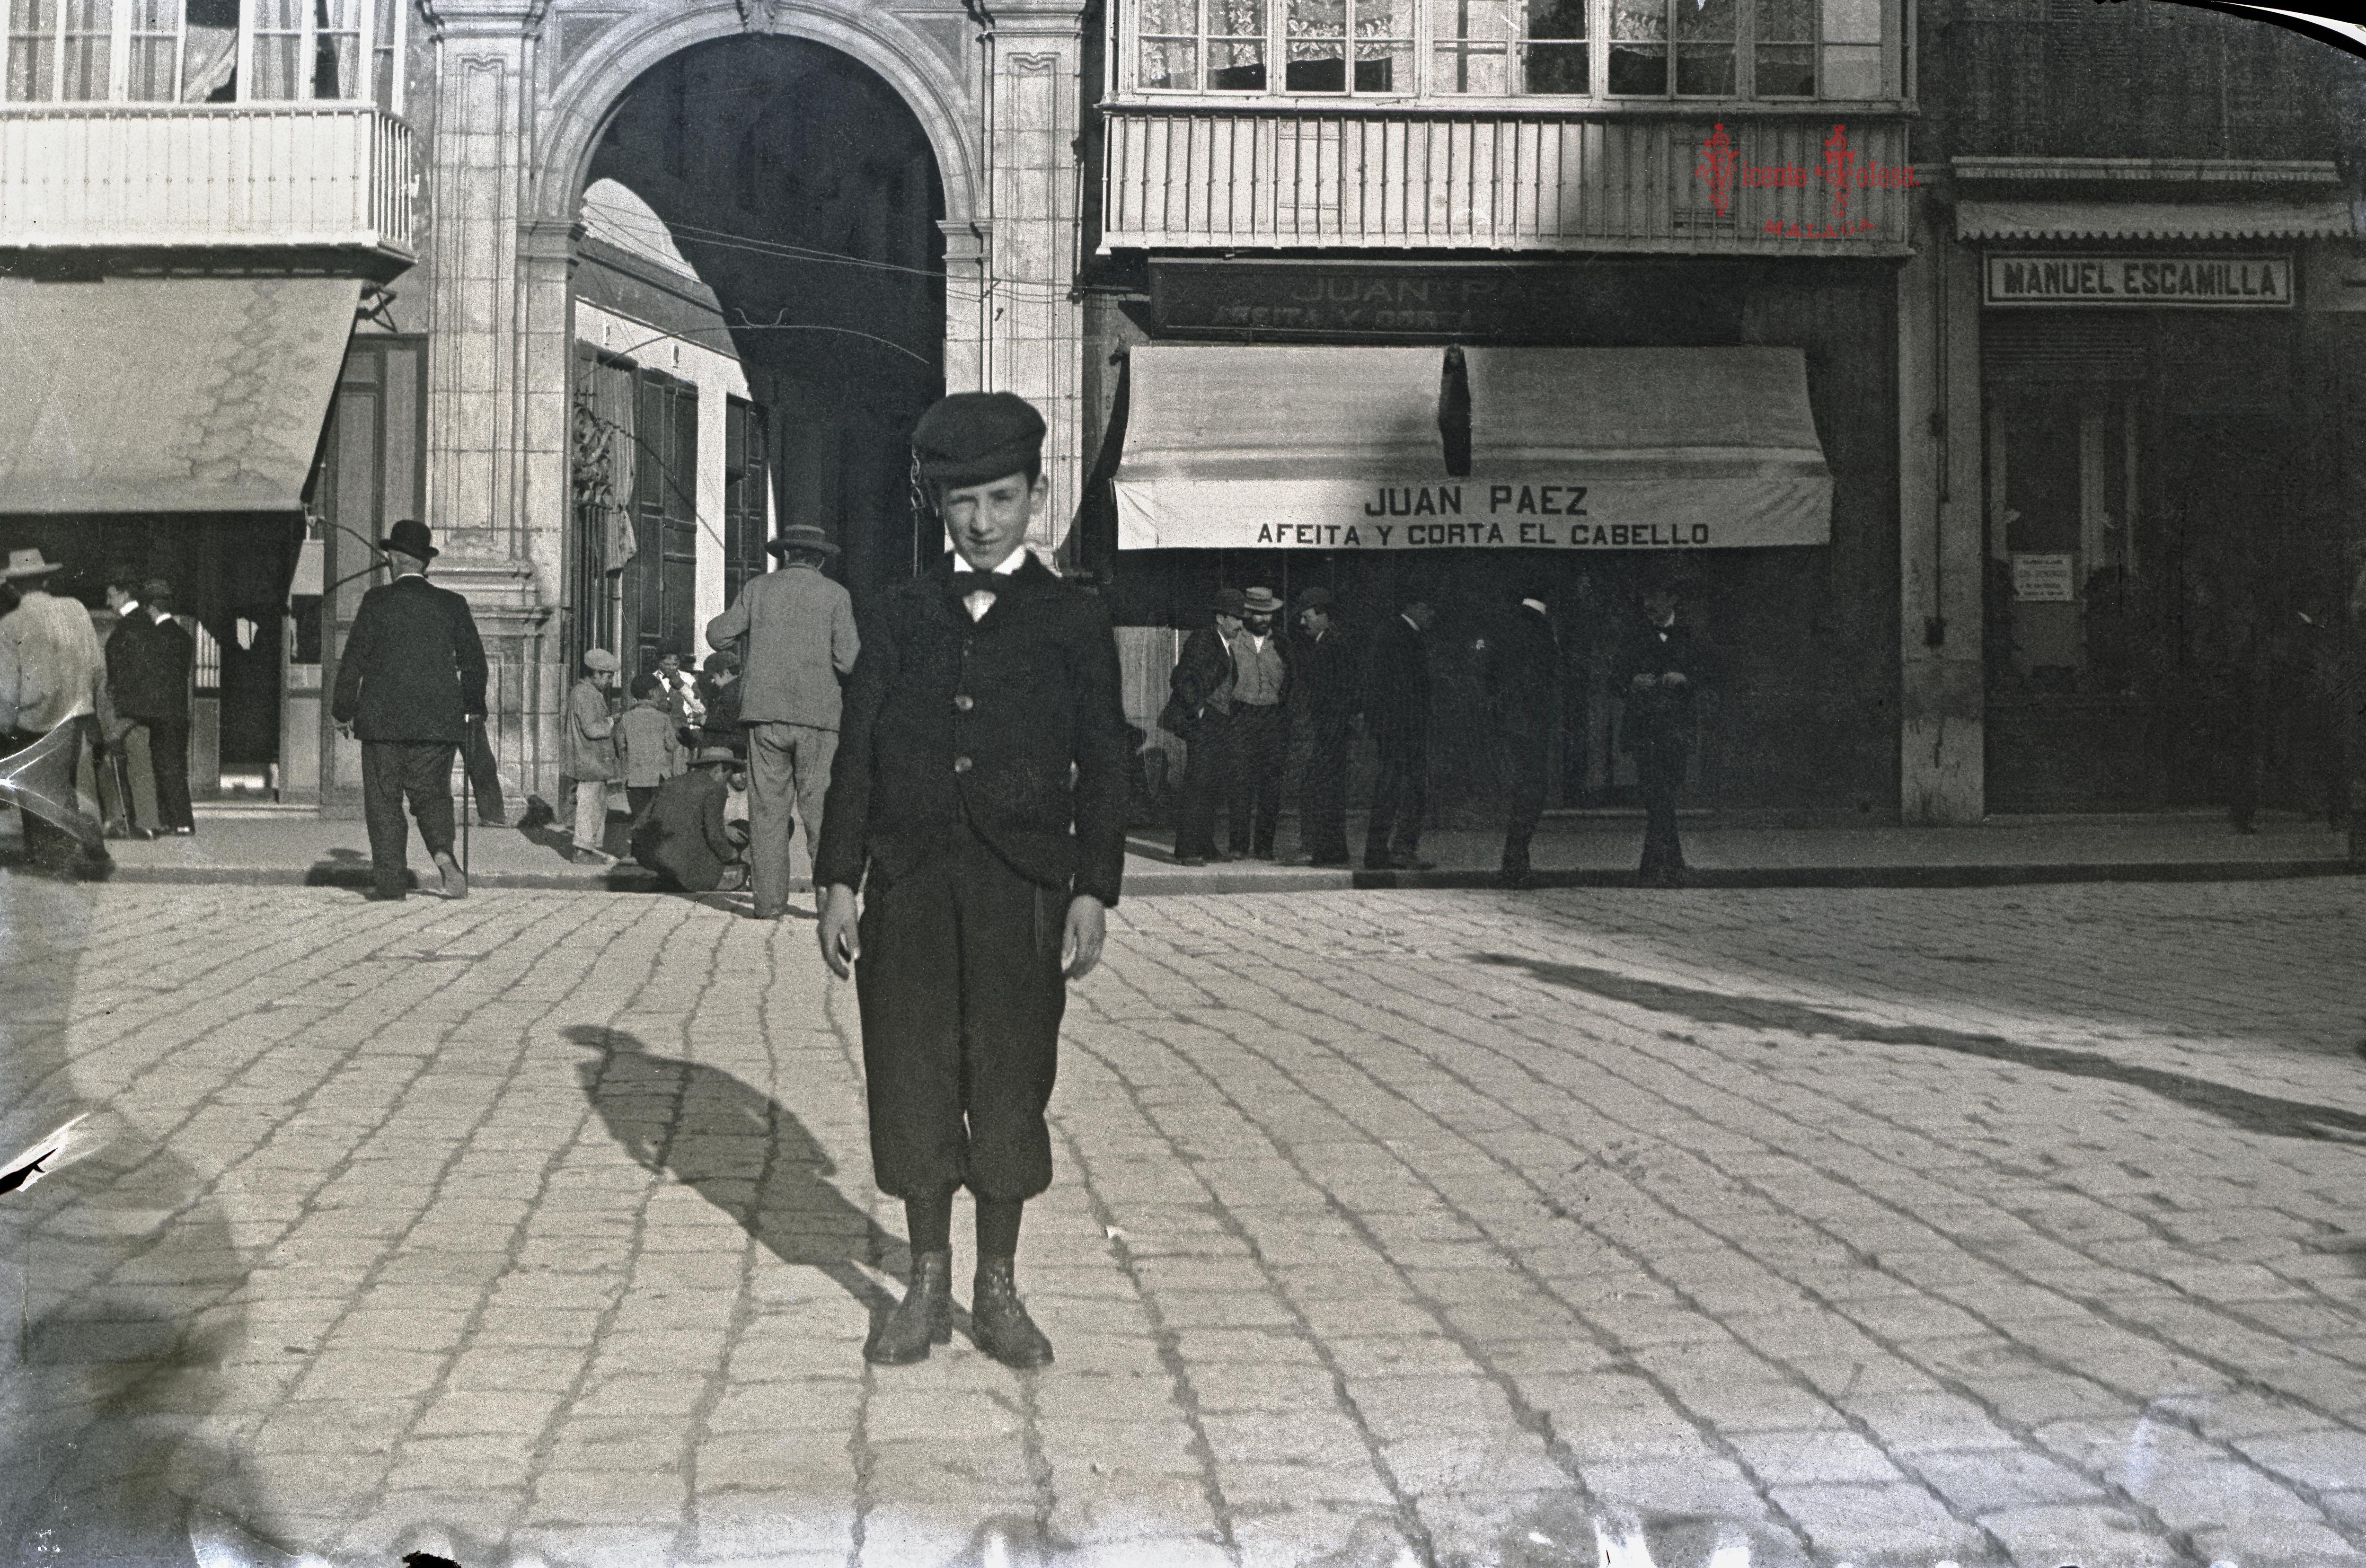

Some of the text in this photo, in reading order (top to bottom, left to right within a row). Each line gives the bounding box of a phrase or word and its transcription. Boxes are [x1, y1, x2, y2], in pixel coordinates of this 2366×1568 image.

[1291, 278, 1430, 302] JUAN
[2004, 262, 2277, 295] MANUEL ESCAMILLA
[1365, 485, 1588, 517] JUAN PAEZ
[1257, 522, 1709, 546] AFEITA Y CORTA EL CABELLO
